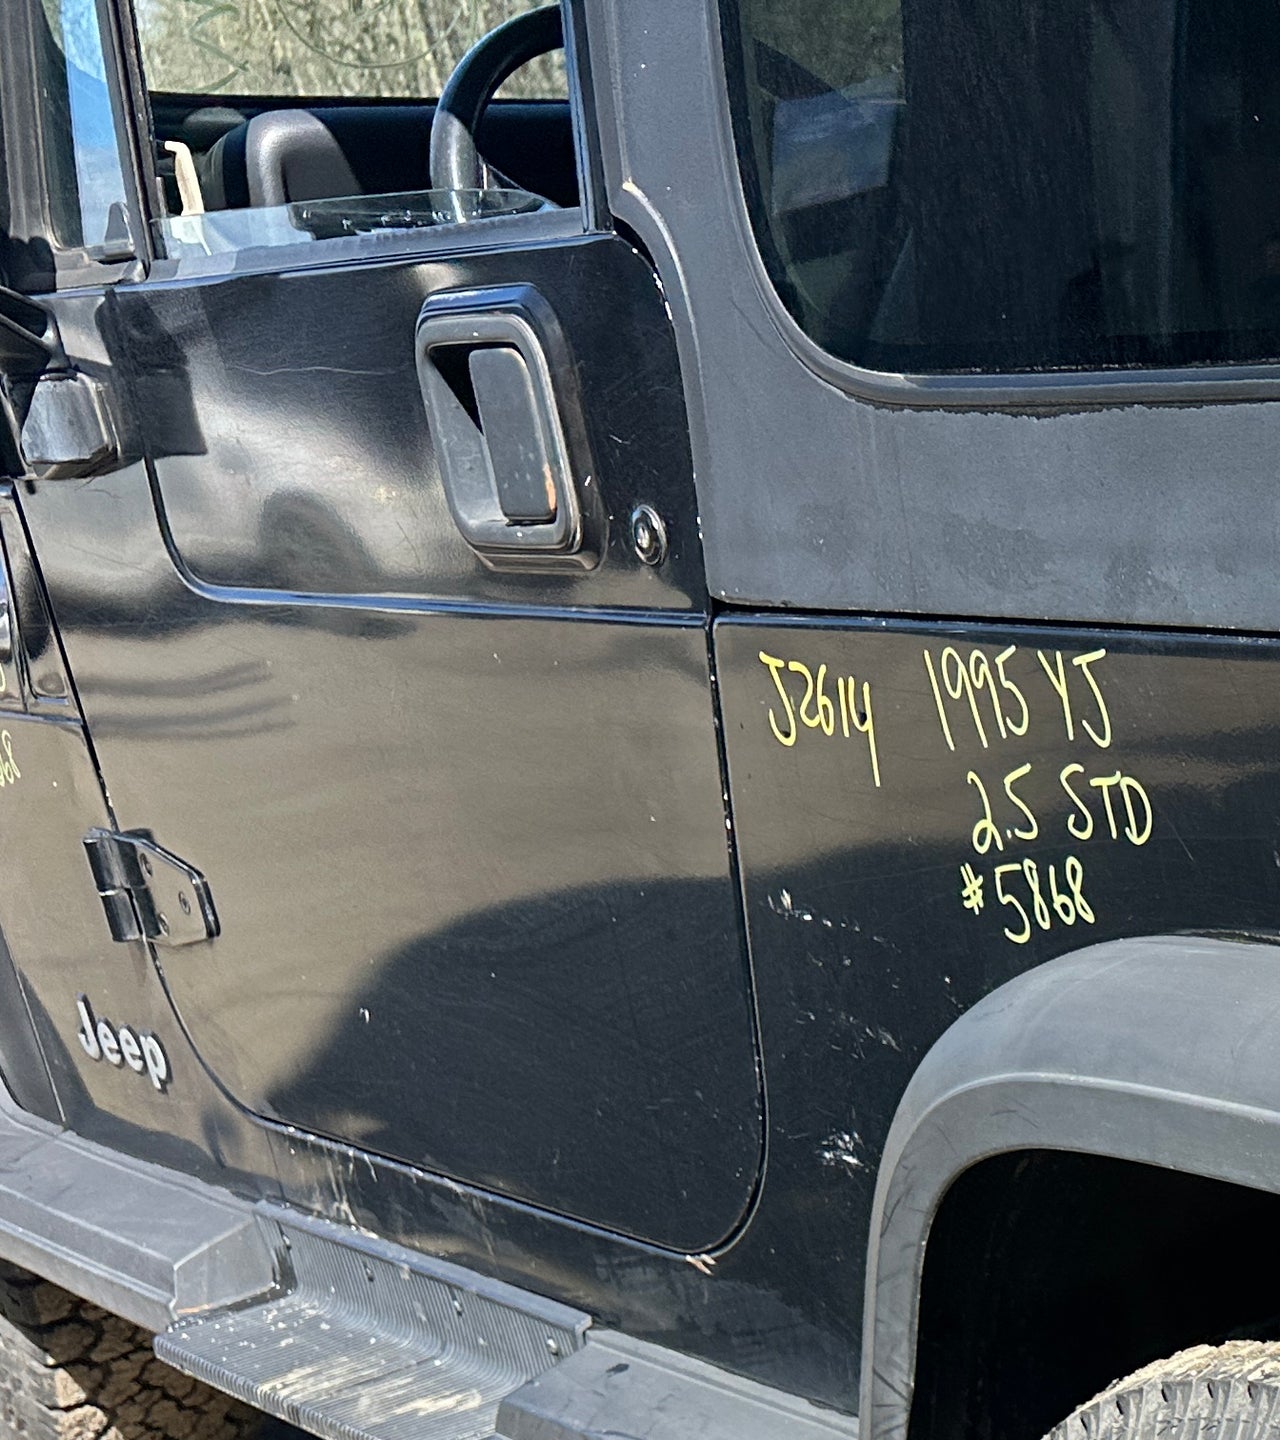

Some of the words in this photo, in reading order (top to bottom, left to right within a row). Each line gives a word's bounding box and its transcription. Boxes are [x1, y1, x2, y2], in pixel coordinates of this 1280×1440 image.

[759, 650, 881, 787] J2614
[923, 645, 1029, 751] 1995
[1037, 648, 1113, 748] YJ
[967, 763, 1039, 855] 2.5
[1059, 763, 1153, 846] STD
[959, 857, 1096, 944] #5868
[76, 993, 172, 1093] Jeep
